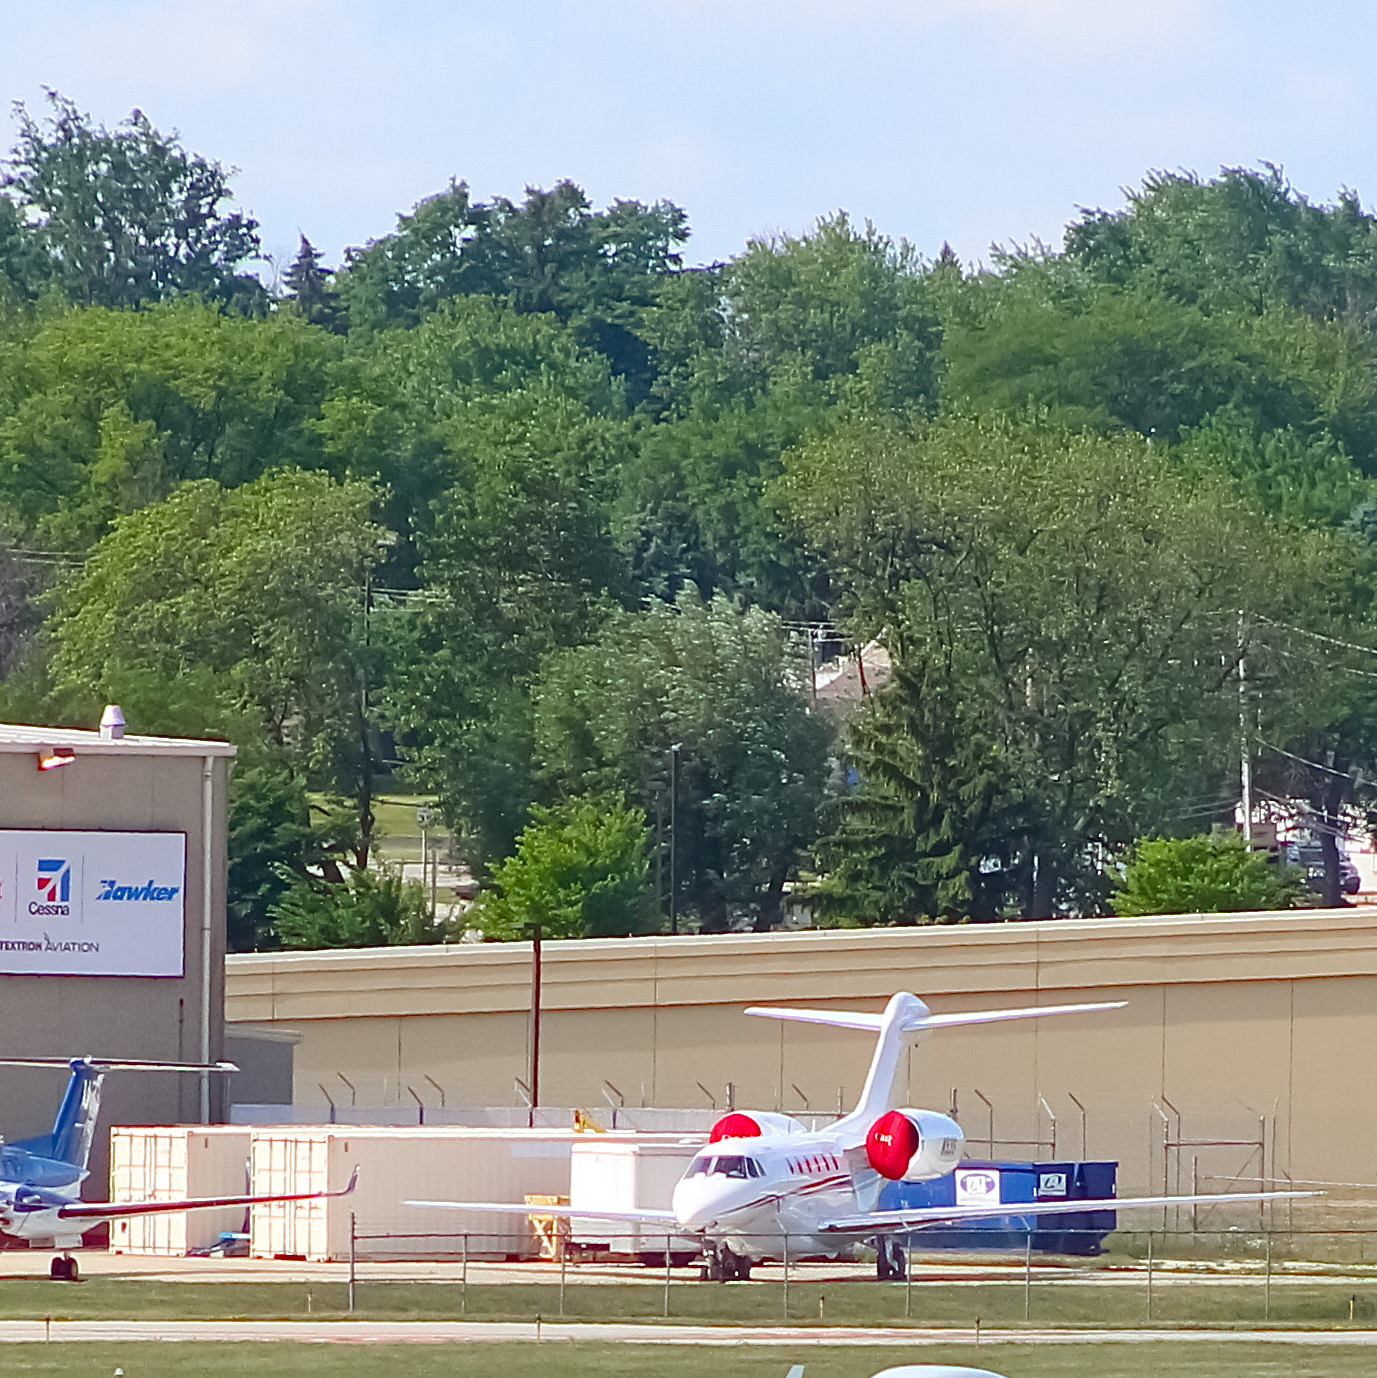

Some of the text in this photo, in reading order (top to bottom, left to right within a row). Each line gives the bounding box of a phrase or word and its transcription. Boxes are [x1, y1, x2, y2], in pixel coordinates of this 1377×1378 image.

[95, 879, 180, 902] Hawker
[28, 901, 70, 916] Cessna
[44, 935, 100, 953] AVIATION
